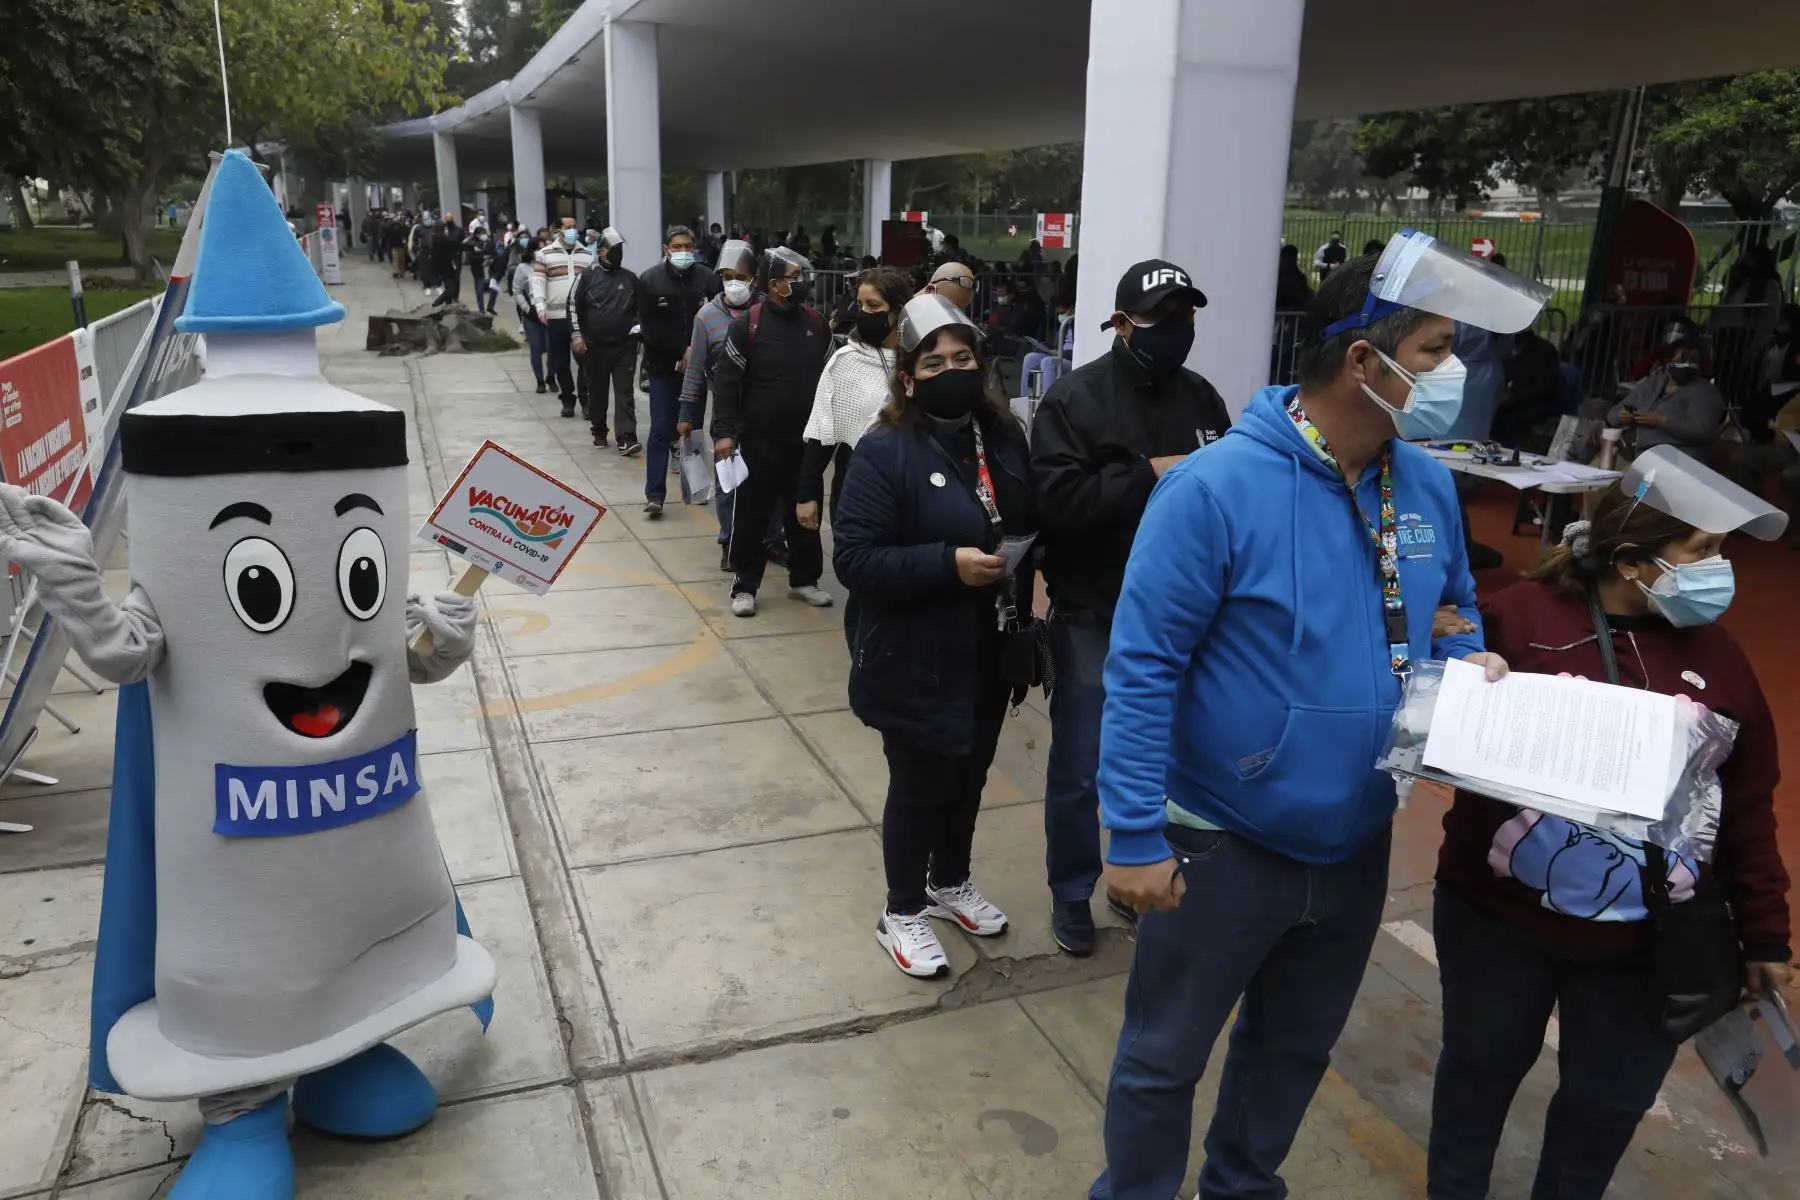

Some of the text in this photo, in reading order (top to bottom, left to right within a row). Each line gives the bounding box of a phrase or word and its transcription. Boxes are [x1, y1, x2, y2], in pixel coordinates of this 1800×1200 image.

[1142, 268, 1188, 291] UFC
[468, 517, 502, 540] CONTRA
[502, 535, 513, 545] LA
[513, 541, 549, 563] COVID-19
[1414, 528, 1436, 544] CLUB
[228, 751, 409, 822] MINSA
